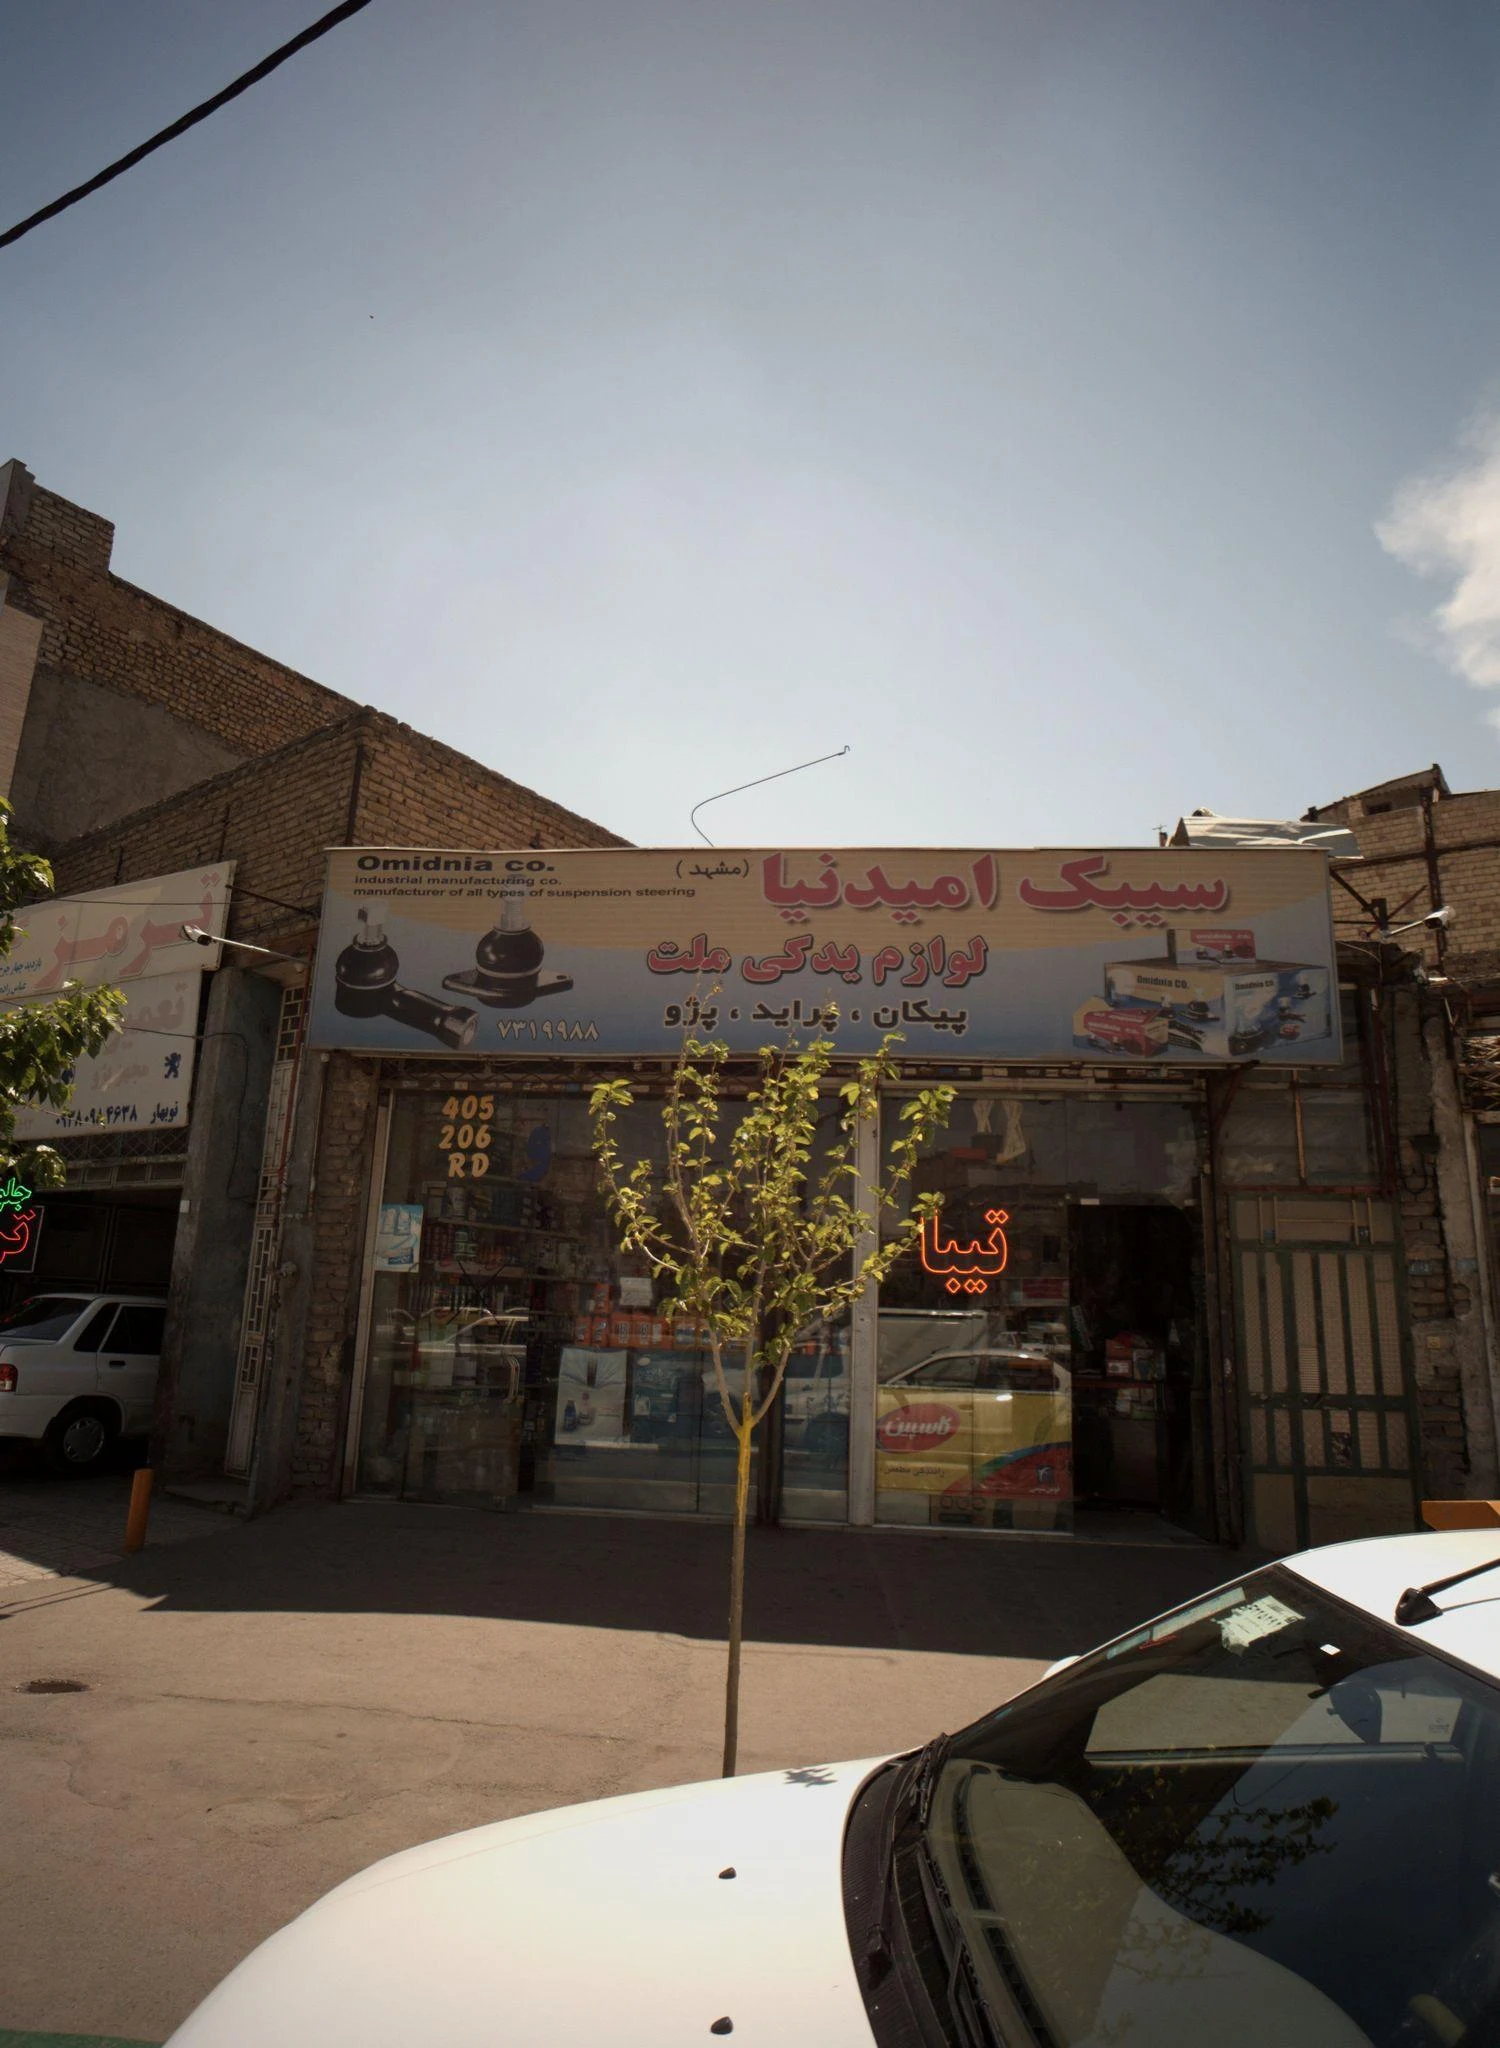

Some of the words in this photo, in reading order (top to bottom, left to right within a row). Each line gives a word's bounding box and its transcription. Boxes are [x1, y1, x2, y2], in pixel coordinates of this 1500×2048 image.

[354, 875, 423, 885] industrial
[427, 876, 535, 887] manufacturing
[357, 855, 493, 872] Omidnia
[505, 860, 555, 872] co.
[353, 887, 445, 897] manufacturer
[449, 887, 463, 897] of
[466, 887, 483, 897] all
[487, 888, 525, 899] types
[529, 888, 544, 897] of
[547, 888, 632, 899] suspension
[636, 888, 696, 898] steering
[1018, 855, 1228, 926] سیبک
[32, 871, 221, 991] ترمز
[647, 932, 733, 975] ملت
[742, 933, 862, 984] یدکی
[872, 934, 989, 988] لوازم
[497, 1019, 600, 1041] ۷۳۱۹۹۸۸
[663, 995, 718, 1033] پژو
[752, 998, 840, 1033] پراید
[873, 999, 969, 1034] پیکان
[441, 1094, 495, 1121] 405
[438, 1123, 492, 1150] 206
[447, 1151, 490, 1178] RD
[920, 1206, 1009, 1294] تیبا
[884, 1415, 952, 1440] کاسپین
